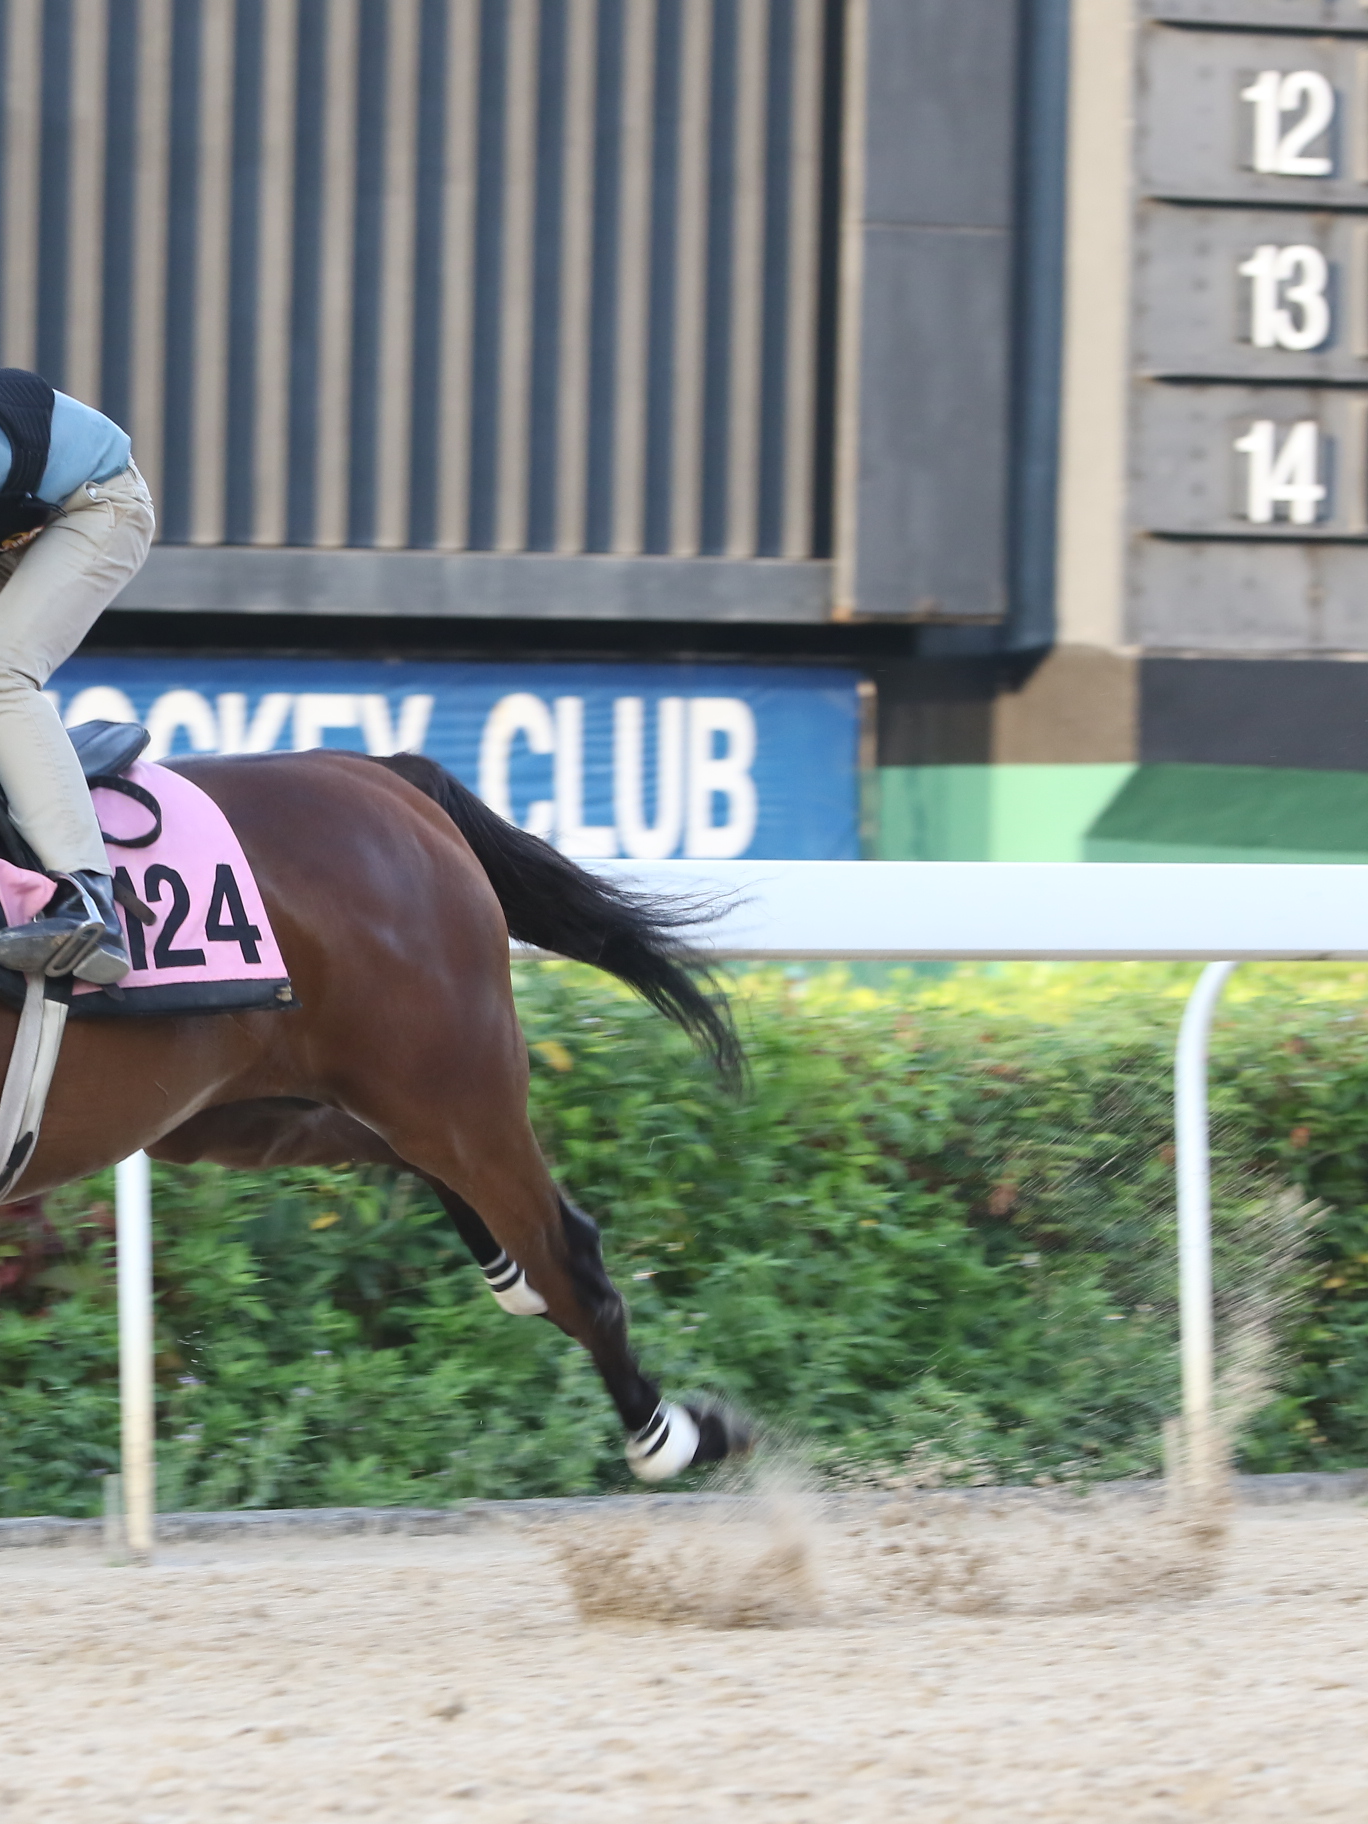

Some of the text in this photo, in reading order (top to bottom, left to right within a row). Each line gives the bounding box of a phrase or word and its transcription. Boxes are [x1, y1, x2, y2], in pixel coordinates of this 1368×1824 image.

[1241, 70, 1333, 175] 12
[1238, 244, 1330, 350] 13
[1234, 420, 1326, 524] 14
[478, 692, 758, 859] CLUB
